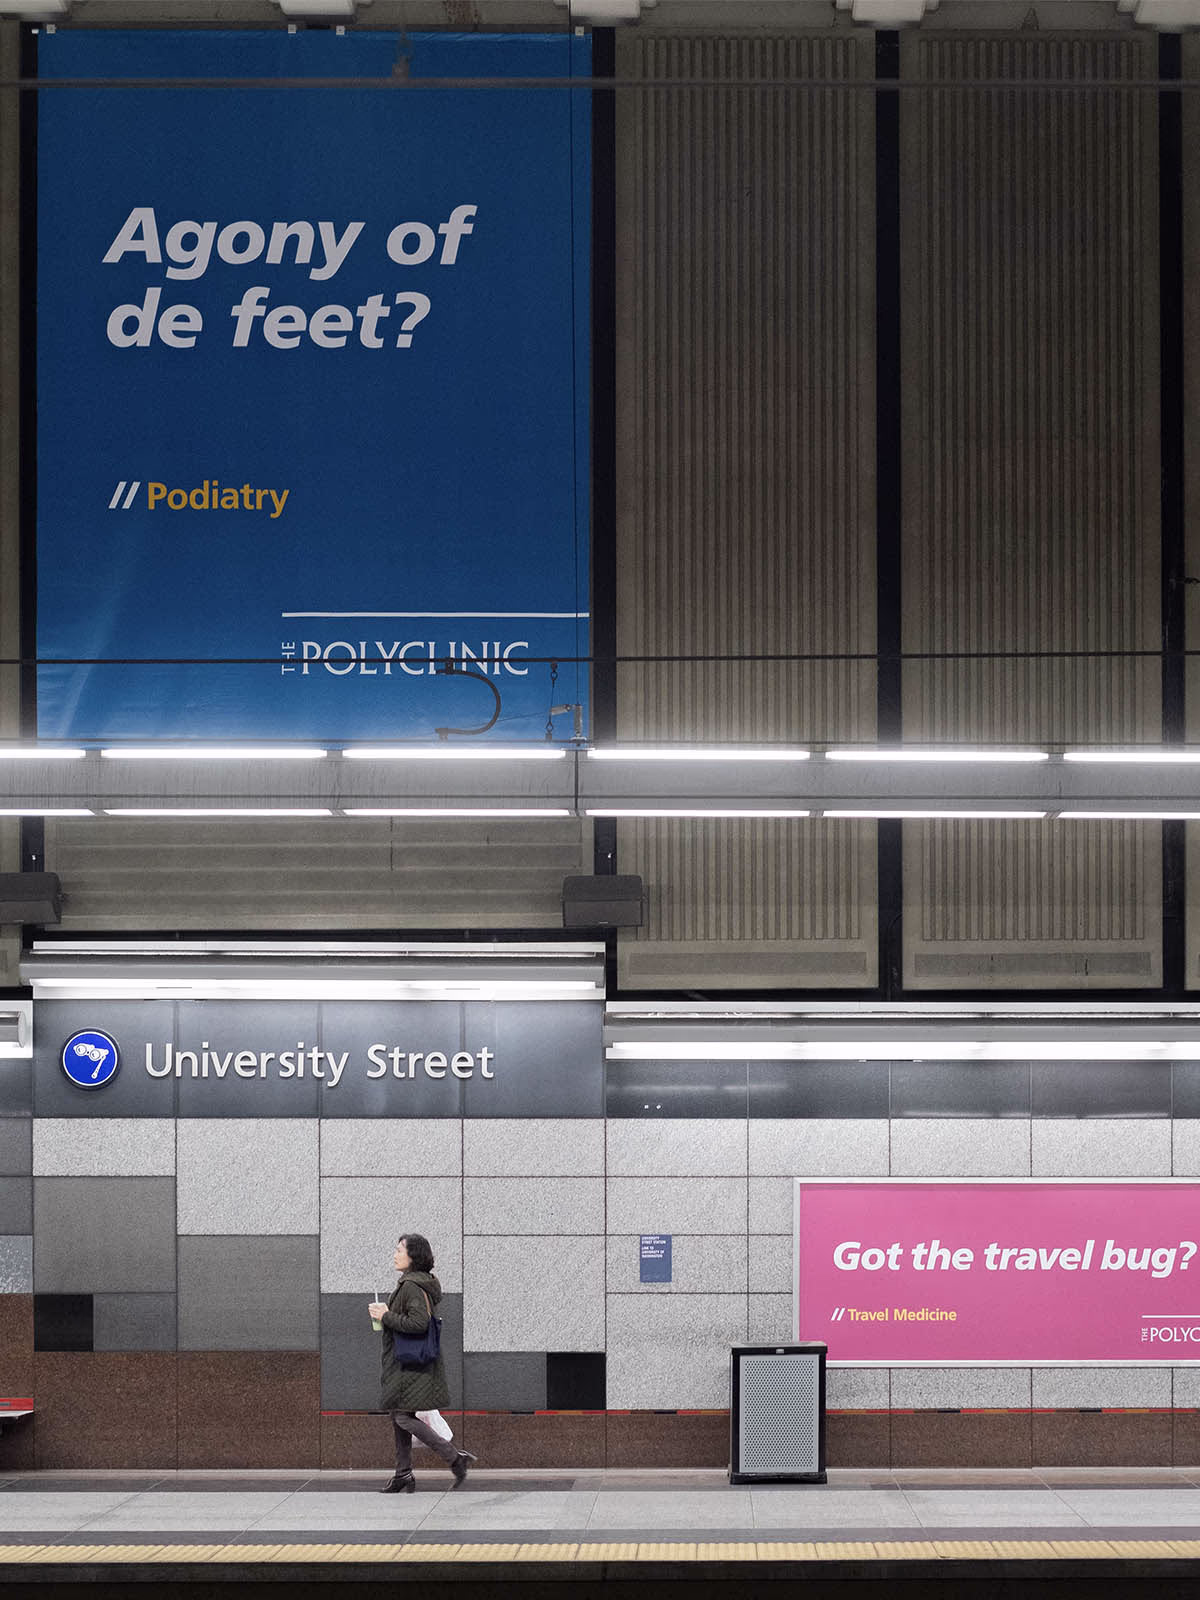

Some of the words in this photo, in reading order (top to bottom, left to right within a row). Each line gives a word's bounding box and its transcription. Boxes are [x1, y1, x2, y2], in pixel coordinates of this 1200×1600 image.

[102, 207, 365, 280] Agony
[386, 204, 478, 266] of
[106, 286, 203, 349] de
[230, 286, 432, 349] feet?
[147, 480, 290, 519] Podiatry
[145, 1040, 349, 1087] University
[366, 1043, 495, 1079] Street
[833, 1241, 903, 1271] Got
[911, 1239, 973, 1271] the
[983, 1239, 1094, 1271] travel
[1100, 1239, 1198, 1279] bug?
[848, 1307, 889, 1321] Travel
[893, 1307, 957, 1321] Medicine
[1141, 1327, 1149, 1342] THE
